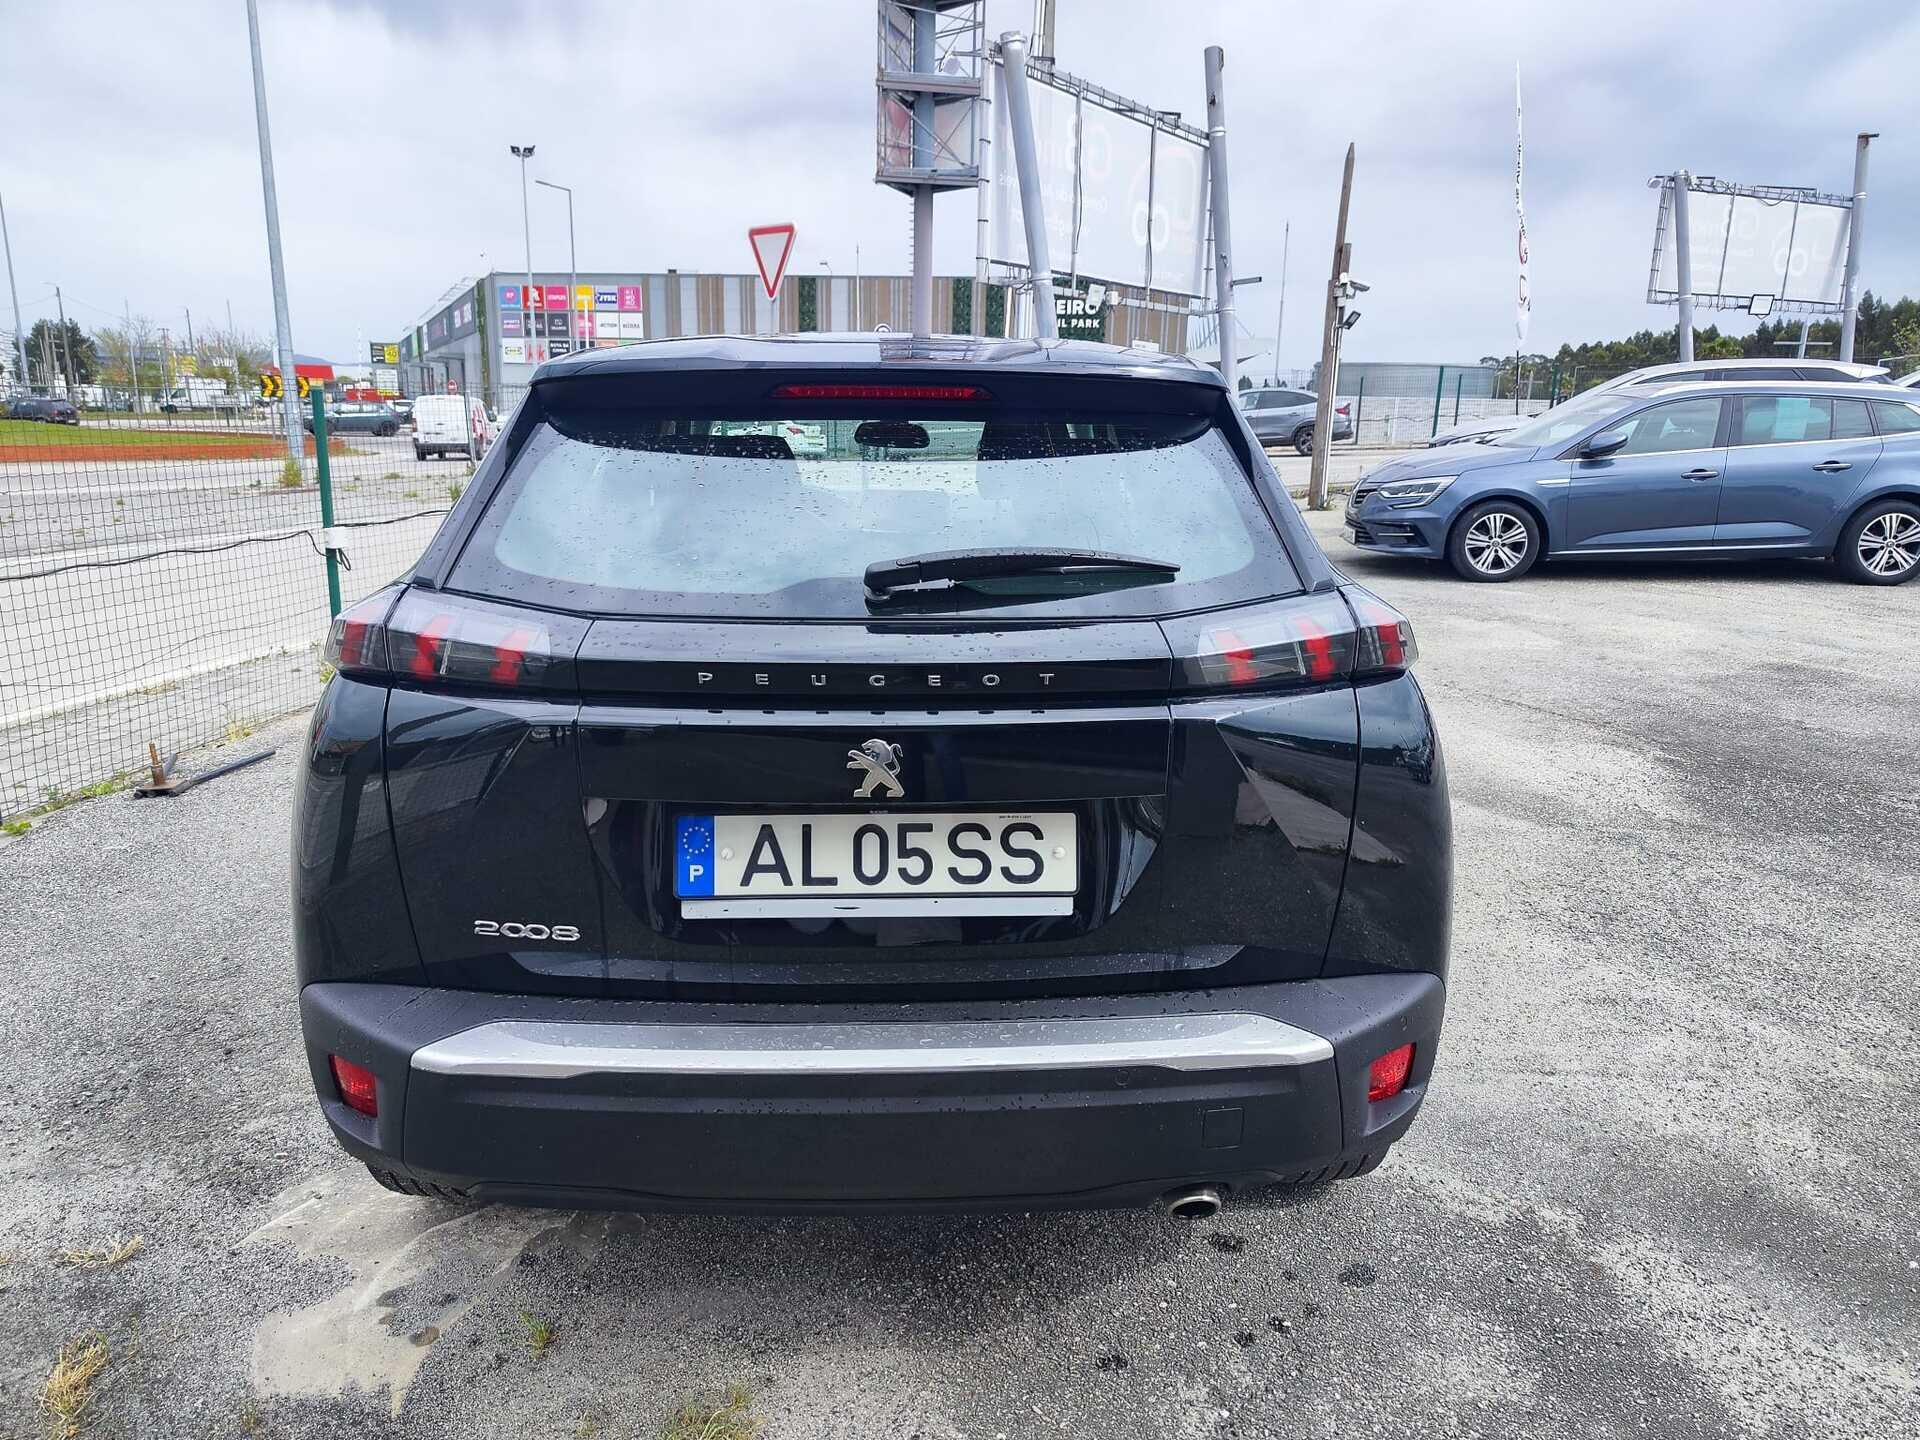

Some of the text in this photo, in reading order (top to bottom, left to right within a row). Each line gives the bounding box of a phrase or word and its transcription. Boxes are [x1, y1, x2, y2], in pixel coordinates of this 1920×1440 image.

[1056, 299, 1101, 315] EIRO
[1071, 319, 1100, 328] PARK
[698, 672, 1054, 687] PEUGEOT
[689, 864, 704, 882] P
[474, 920, 581, 941] 2008
